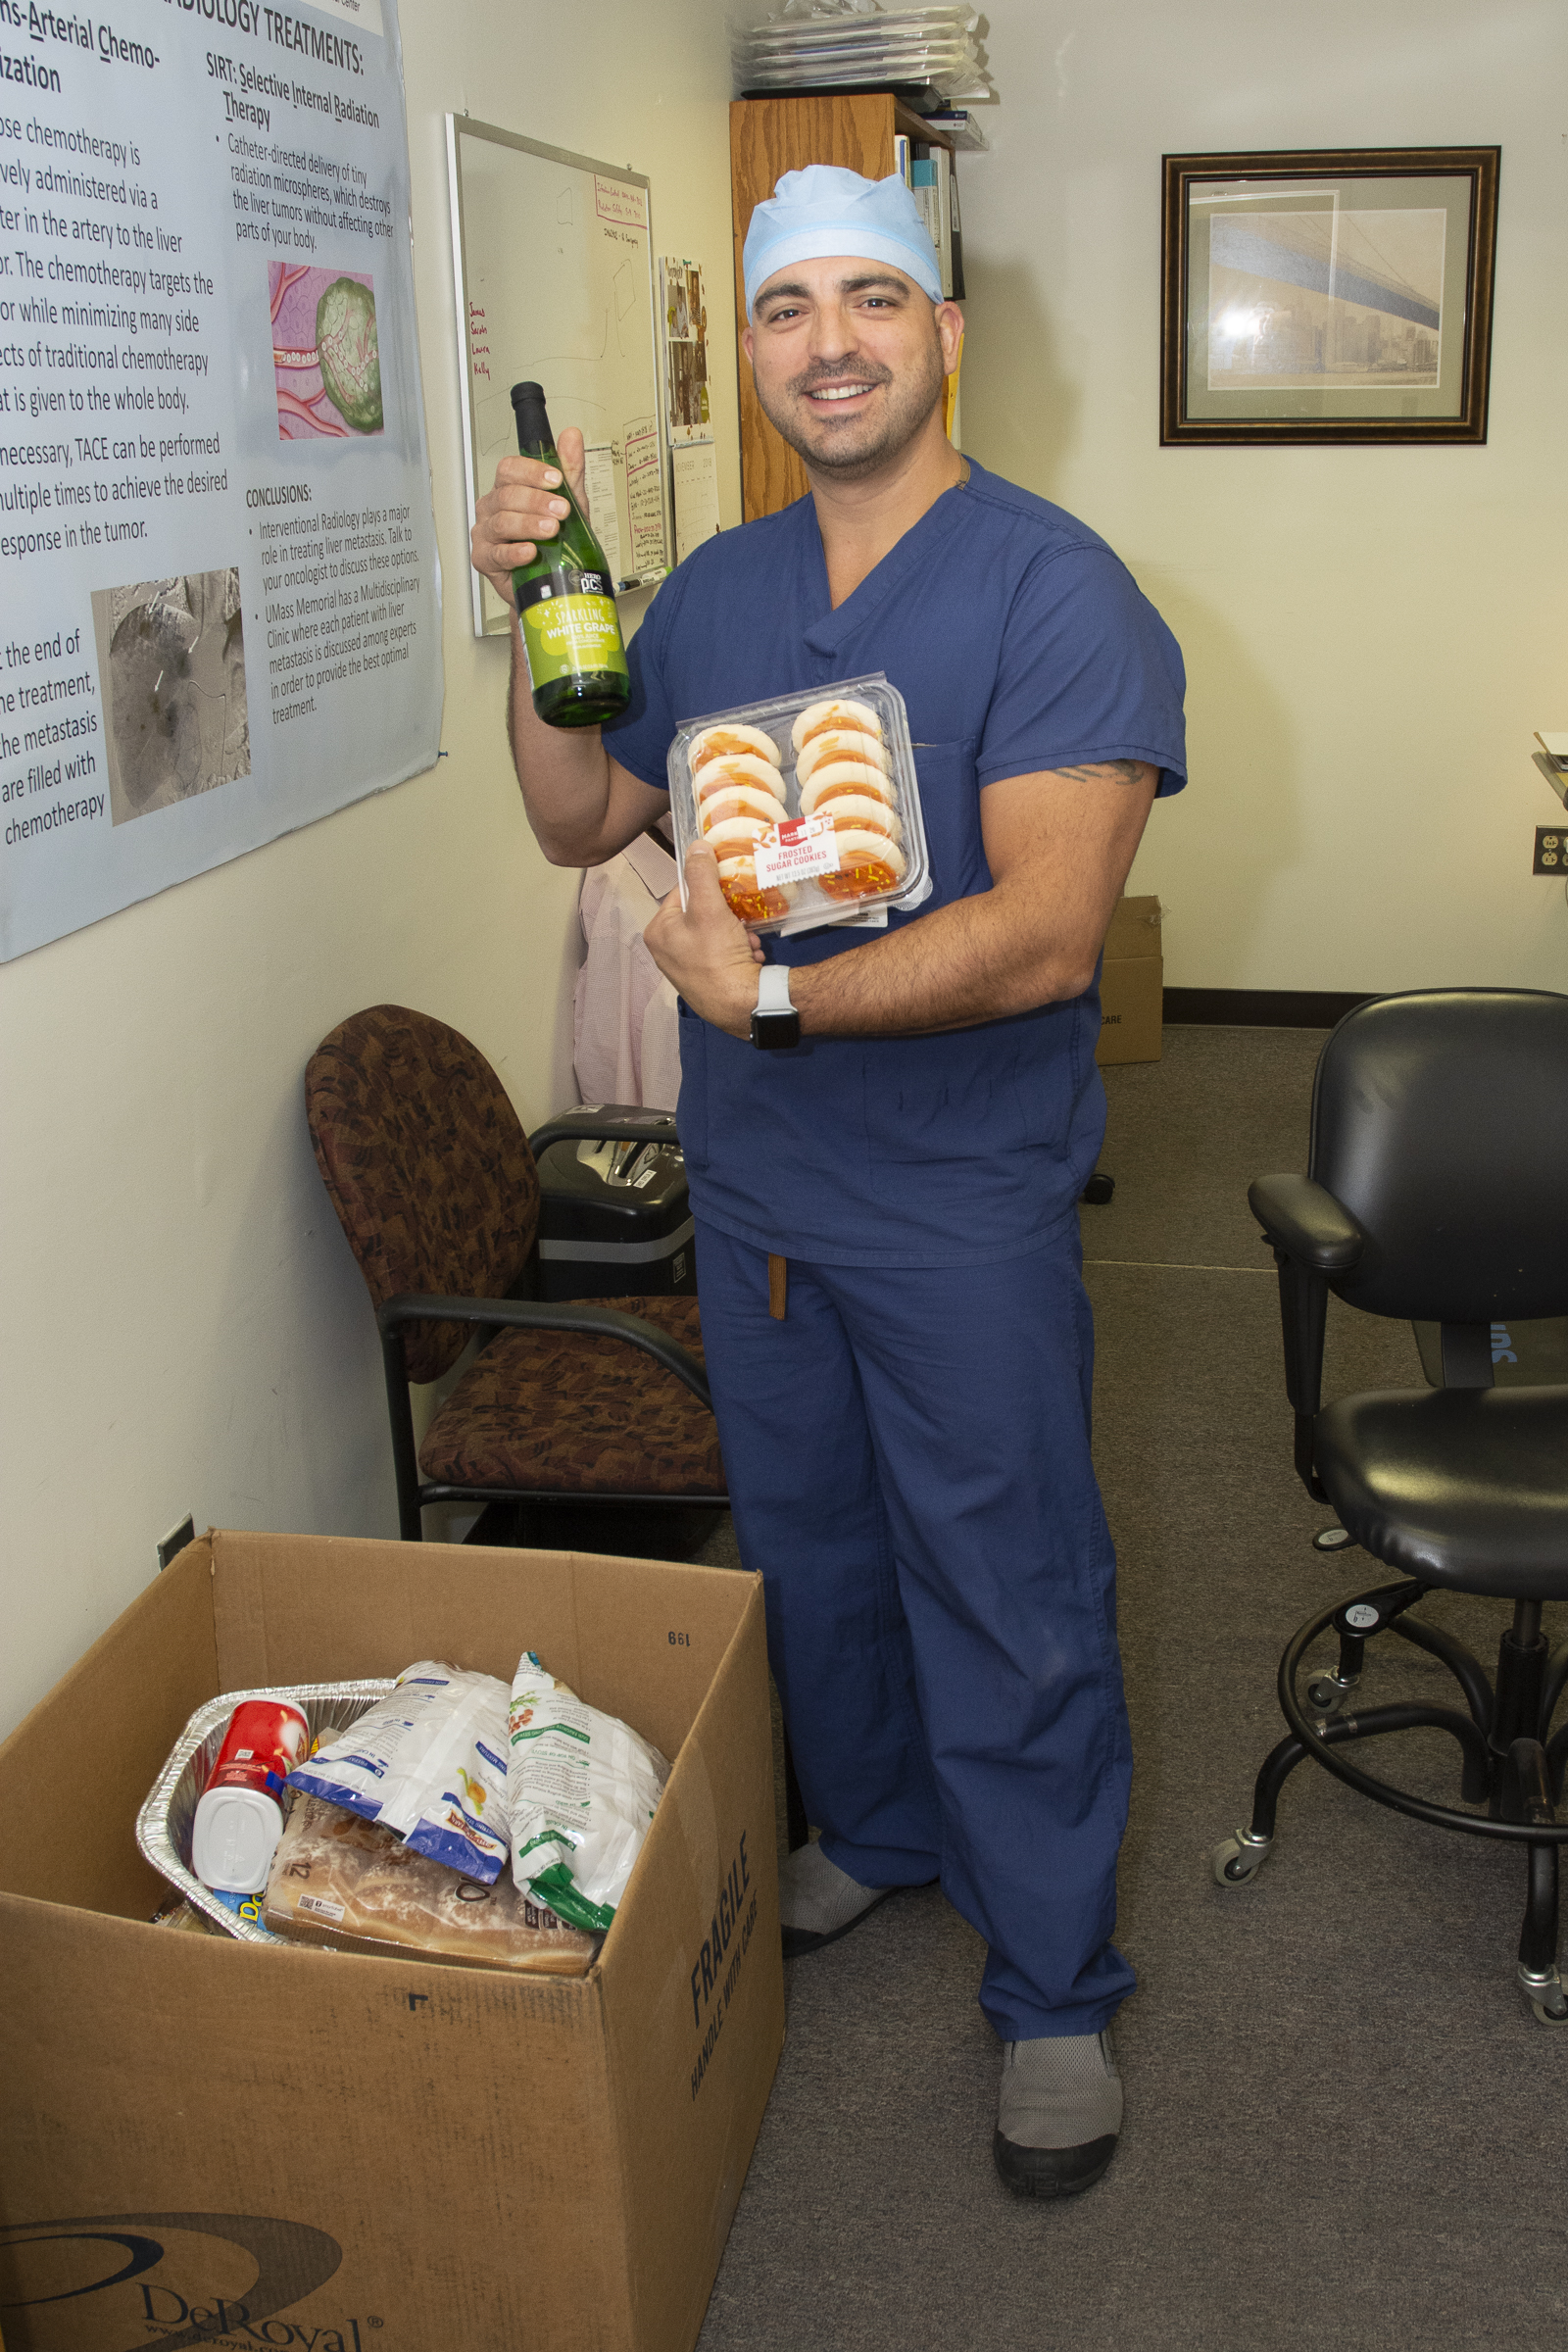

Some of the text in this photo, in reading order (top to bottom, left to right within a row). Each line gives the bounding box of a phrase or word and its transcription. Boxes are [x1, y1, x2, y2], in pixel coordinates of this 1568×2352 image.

[99, 25, 160, 69] Chemo-
[264, 7, 364, 75] TREATMENTS:
[207, 52, 379, 128] SIRT: Selective Internal Radiation
[223, 90, 270, 131] Therapy
[26, 117, 126, 169] chemotherapy
[130, 141, 140, 166] is
[228, 133, 367, 189] Catheter-directed delivery of tiny
[35, 166, 126, 204] administered
[129, 183, 147, 208] via
[151, 192, 158, 210] a
[231, 166, 390, 217] radiation microspheres, which destroys
[24, 207, 38, 233] in
[42, 210, 68, 237] the
[73, 219, 113, 249] artery
[117, 223, 129, 245] to
[133, 223, 153, 249] the
[156, 226, 182, 253] liver
[233, 190, 393, 238] the liver tumors without affecting other
[236, 221, 317, 253] parts of your body.
[16, 251, 43, 278] The
[48, 255, 146, 294] chemotherapy
[149, 269, 191, 297] targets
[194, 271, 213, 295] the
[20, 297, 57, 323] while
[62, 301, 137, 334] minimizing
[140, 312, 172, 336] many
[176, 310, 199, 332] side
[28, 341, 41, 367] of
[46, 343, 118, 368] traditional
[122, 345, 208, 375] chemotherapy
[14, 386, 25, 412] is
[30, 386, 66, 417] given
[70, 389, 83, 411] to
[87, 386, 110, 411] the
[115, 386, 154, 410] whole
[157, 386, 189, 415] body.
[0, 432, 220, 467] necessary, TACE can be performed
[55, 482, 90, 506] times
[94, 481, 108, 503] to
[112, 475, 161, 501] achieve
[164, 472, 183, 495] the
[187, 468, 227, 493] desired
[247, 484, 312, 508] CONCLUSIONS:
[65, 524, 76, 547] in
[80, 520, 101, 545] the
[105, 520, 147, 542] tumor.
[260, 505, 411, 539] Interventional Radiology plays a major
[262, 526, 412, 564] role in treating liver metastasis. Talk to
[263, 549, 418, 595] your oncologist to discuss these options.
[266, 577, 419, 623] UMass Memorial has a Multidisciplinary
[555, 608, 606, 625] SPARKLING
[268, 602, 405, 649] Clinic where each patient with liver
[547, 621, 615, 640] WHITE GRAPE
[6, 641, 29, 667] the
[35, 632, 62, 660] end
[66, 628, 79, 654] of
[270, 621, 416, 674] metastasis is discussed among experts
[19, 671, 95, 709] treatment,
[271, 643, 409, 700] in order to provide the best optimal
[24, 710, 97, 751] metastasis
[272, 696, 317, 724] treatment.
[2, 751, 96, 803] are filled with
[5, 793, 105, 845] chemotherapy
[766, 851, 827, 872] SUGAR COOKIES
[778, 845, 812, 860] FROSTED
[289, 1861, 312, 1881] 12
[691, 1829, 750, 2029] FRAGILE
[691, 1889, 758, 2102] HANDLE WITH CARE
